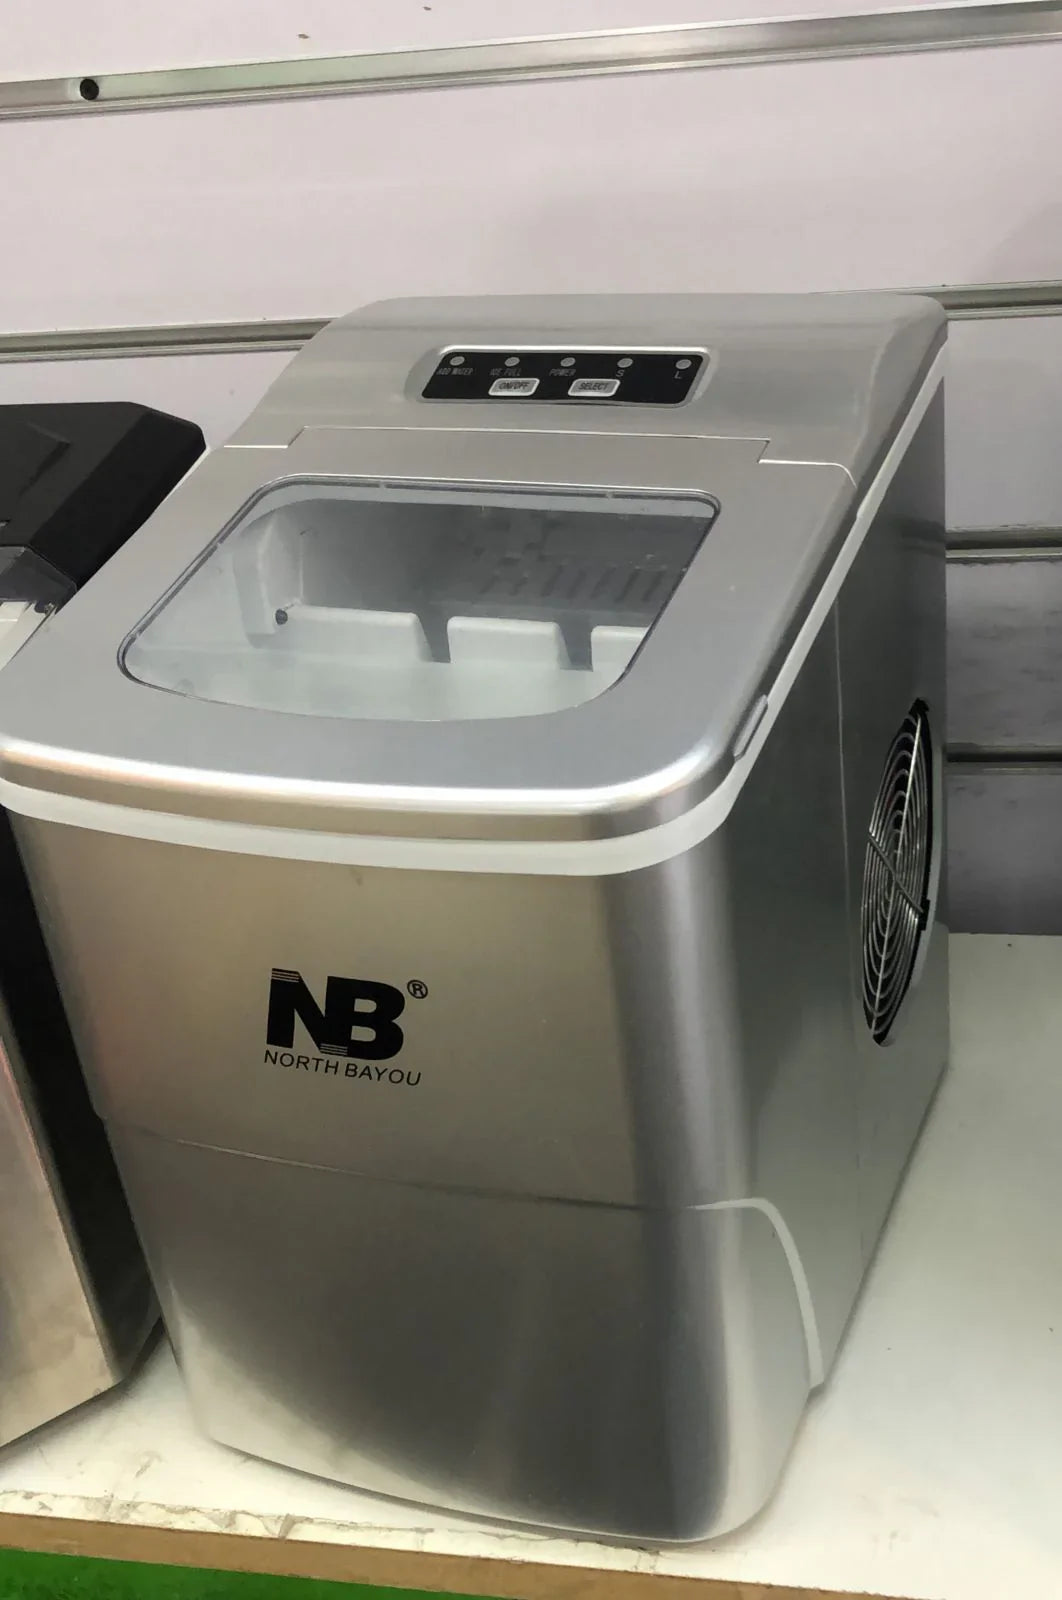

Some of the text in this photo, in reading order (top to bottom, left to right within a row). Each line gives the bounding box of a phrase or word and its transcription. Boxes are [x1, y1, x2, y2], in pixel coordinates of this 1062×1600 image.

[615, 369, 625, 378] S
[674, 370, 683, 380] L
[498, 381, 531, 390] ON/OFF
[577, 382, 609, 391] SELECT
[264, 1049, 422, 1086] NORTH BAYOU
